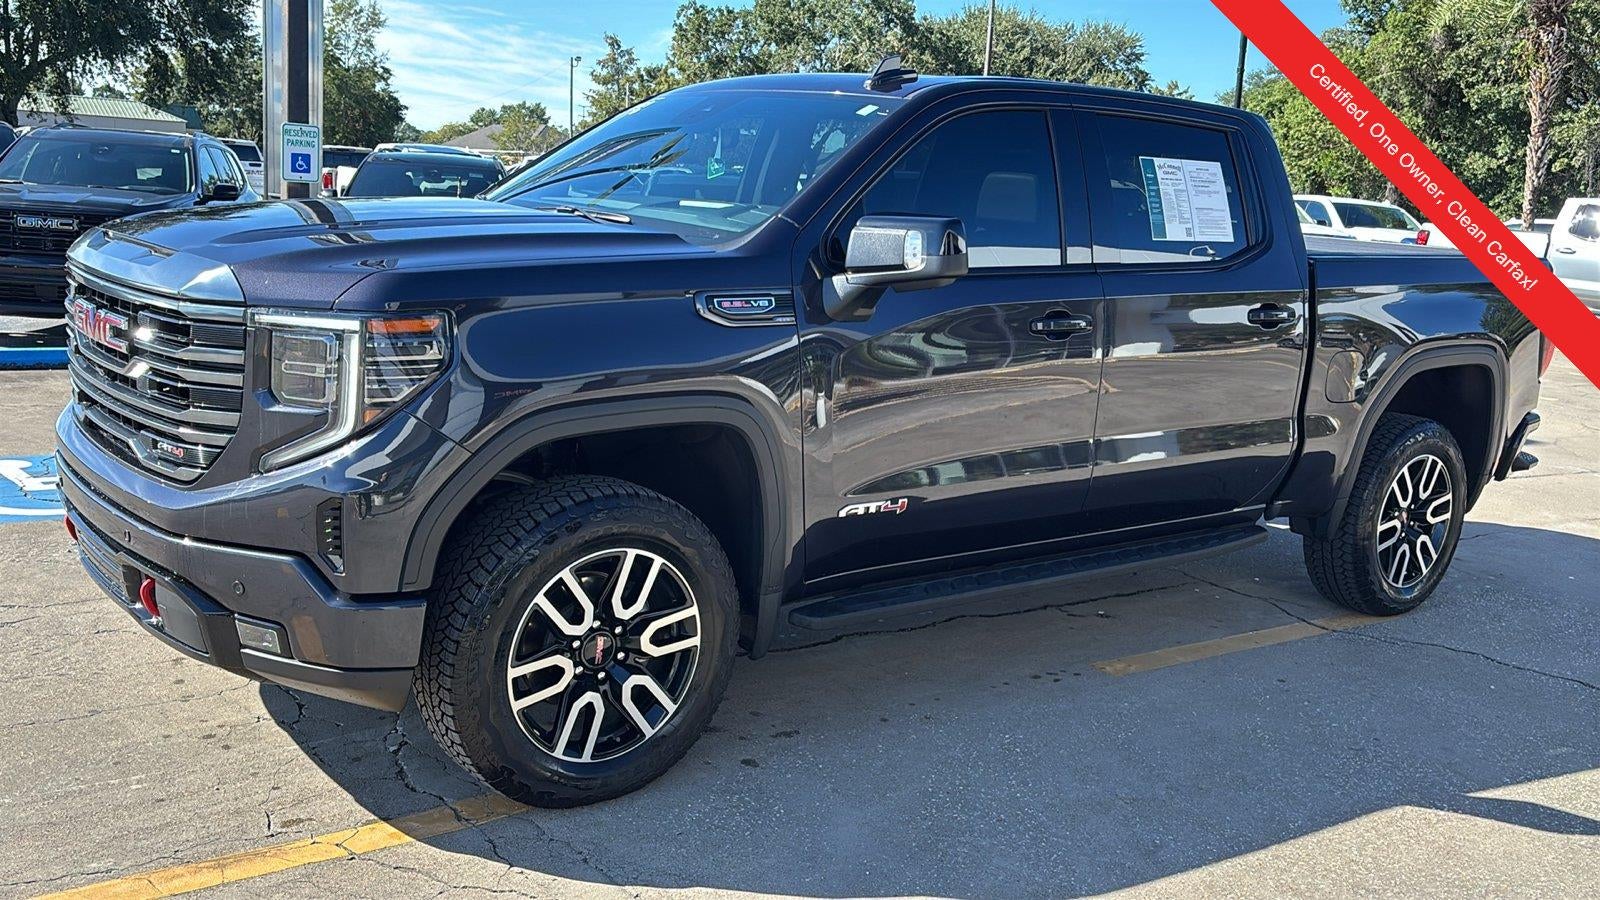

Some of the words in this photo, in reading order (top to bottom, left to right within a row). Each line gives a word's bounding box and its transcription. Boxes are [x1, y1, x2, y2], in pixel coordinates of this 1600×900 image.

[284, 128, 318, 139] RESERVED
[286, 139, 316, 148] PARKING
[17, 215, 77, 230] GMC
[73, 298, 129, 354] GMC
[838, 498, 908, 518] AT4
